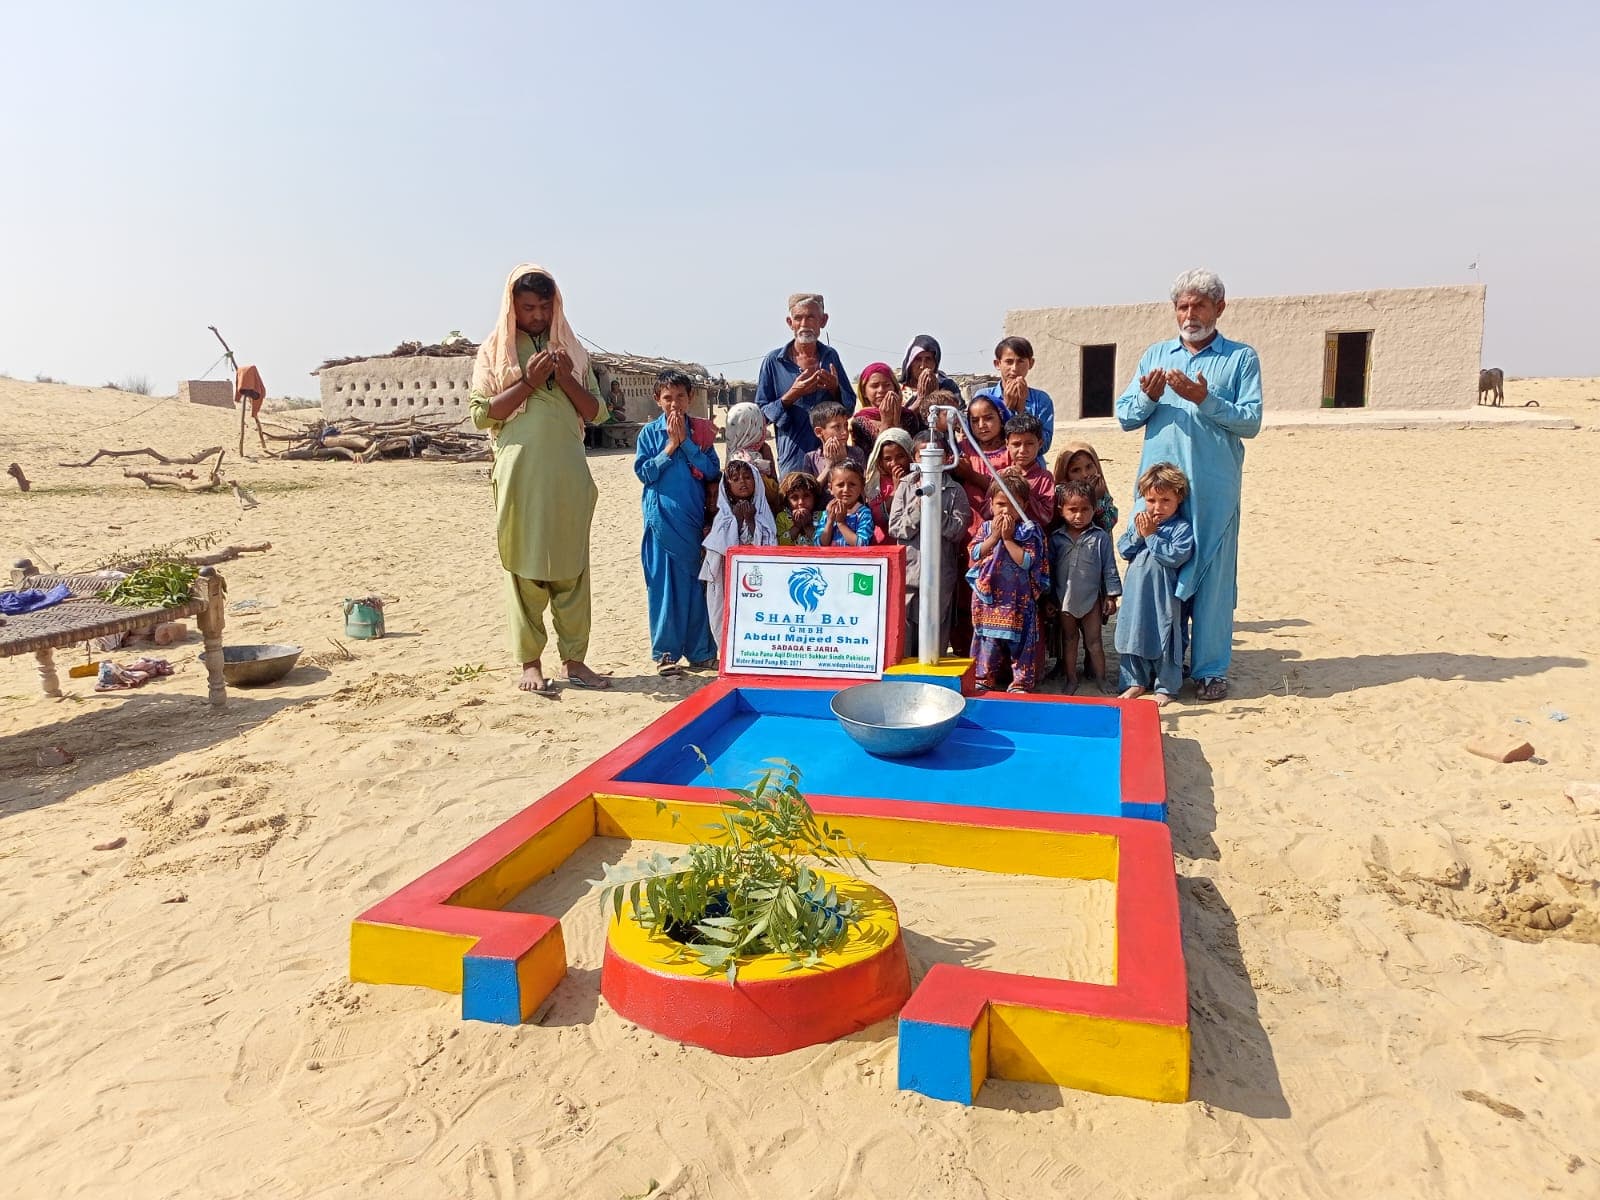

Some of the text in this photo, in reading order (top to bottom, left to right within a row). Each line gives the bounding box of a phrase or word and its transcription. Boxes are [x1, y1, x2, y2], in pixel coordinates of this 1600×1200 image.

[744, 632, 869, 645] Abdul Majeed Shah
[813, 645, 839, 653] JARIA
